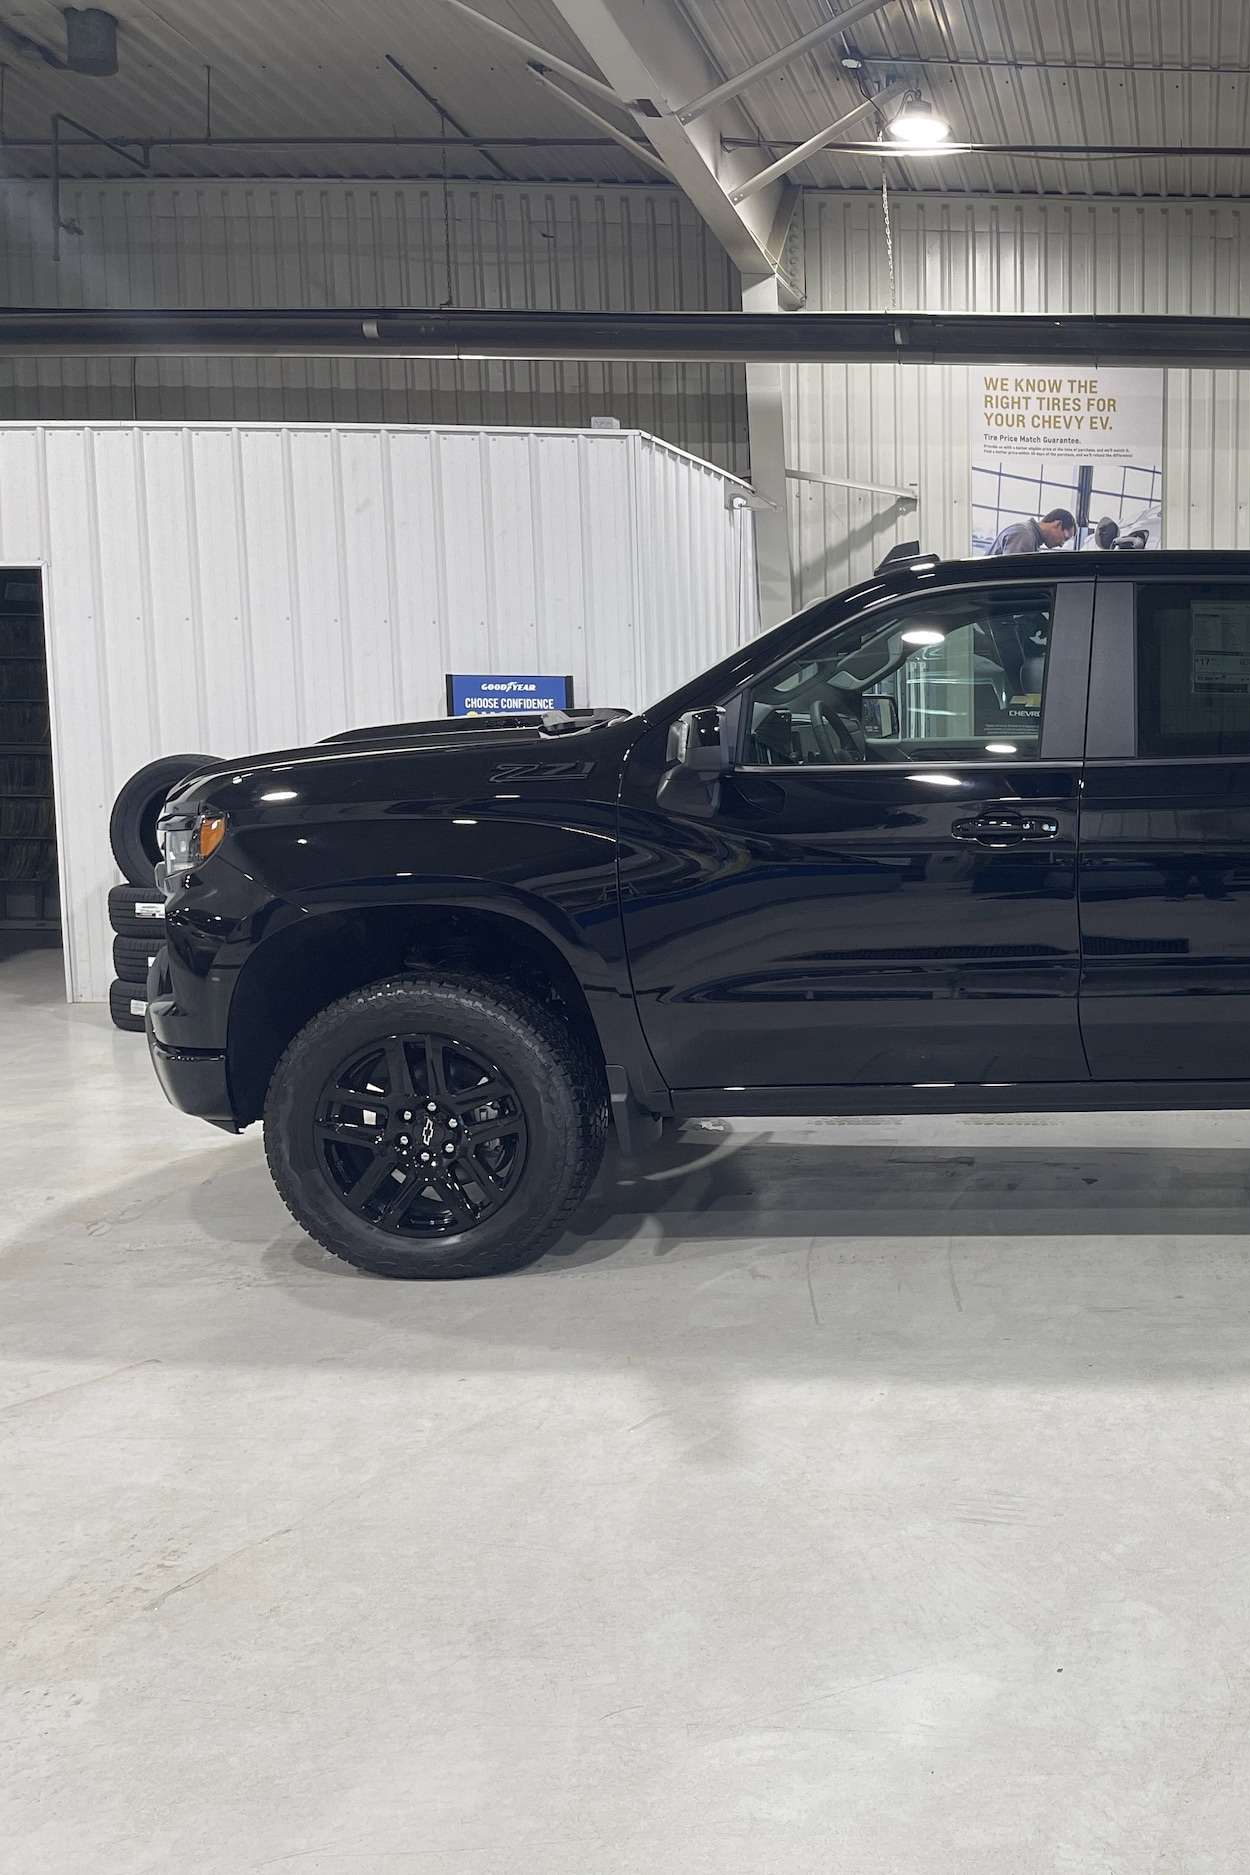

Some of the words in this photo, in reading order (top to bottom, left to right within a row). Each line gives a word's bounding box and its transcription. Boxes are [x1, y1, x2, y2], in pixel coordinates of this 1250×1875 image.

[984, 377, 1009, 392] WE
[1014, 378, 1062, 393] KNOW
[1067, 379, 1098, 394] THE
[984, 395, 1032, 411] RIGHT
[1036, 397, 1082, 412] TIRES
[1087, 398, 1117, 413] FOR
[984, 412, 1026, 428] YOUR
[1031, 414, 1085, 429] CHEVY
[1089, 416, 1113, 430] EV.
[984, 434, 998, 442] Tire
[999, 435, 1018, 443] Price
[1020, 435, 1041, 444] Match
[1042, 436, 1081, 445] Guarantee.
[481, 681, 537, 693] GOODYEAR
[465, 697, 499, 709] CHOOSE
[501, 698, 555, 709] CONFIDENCE
